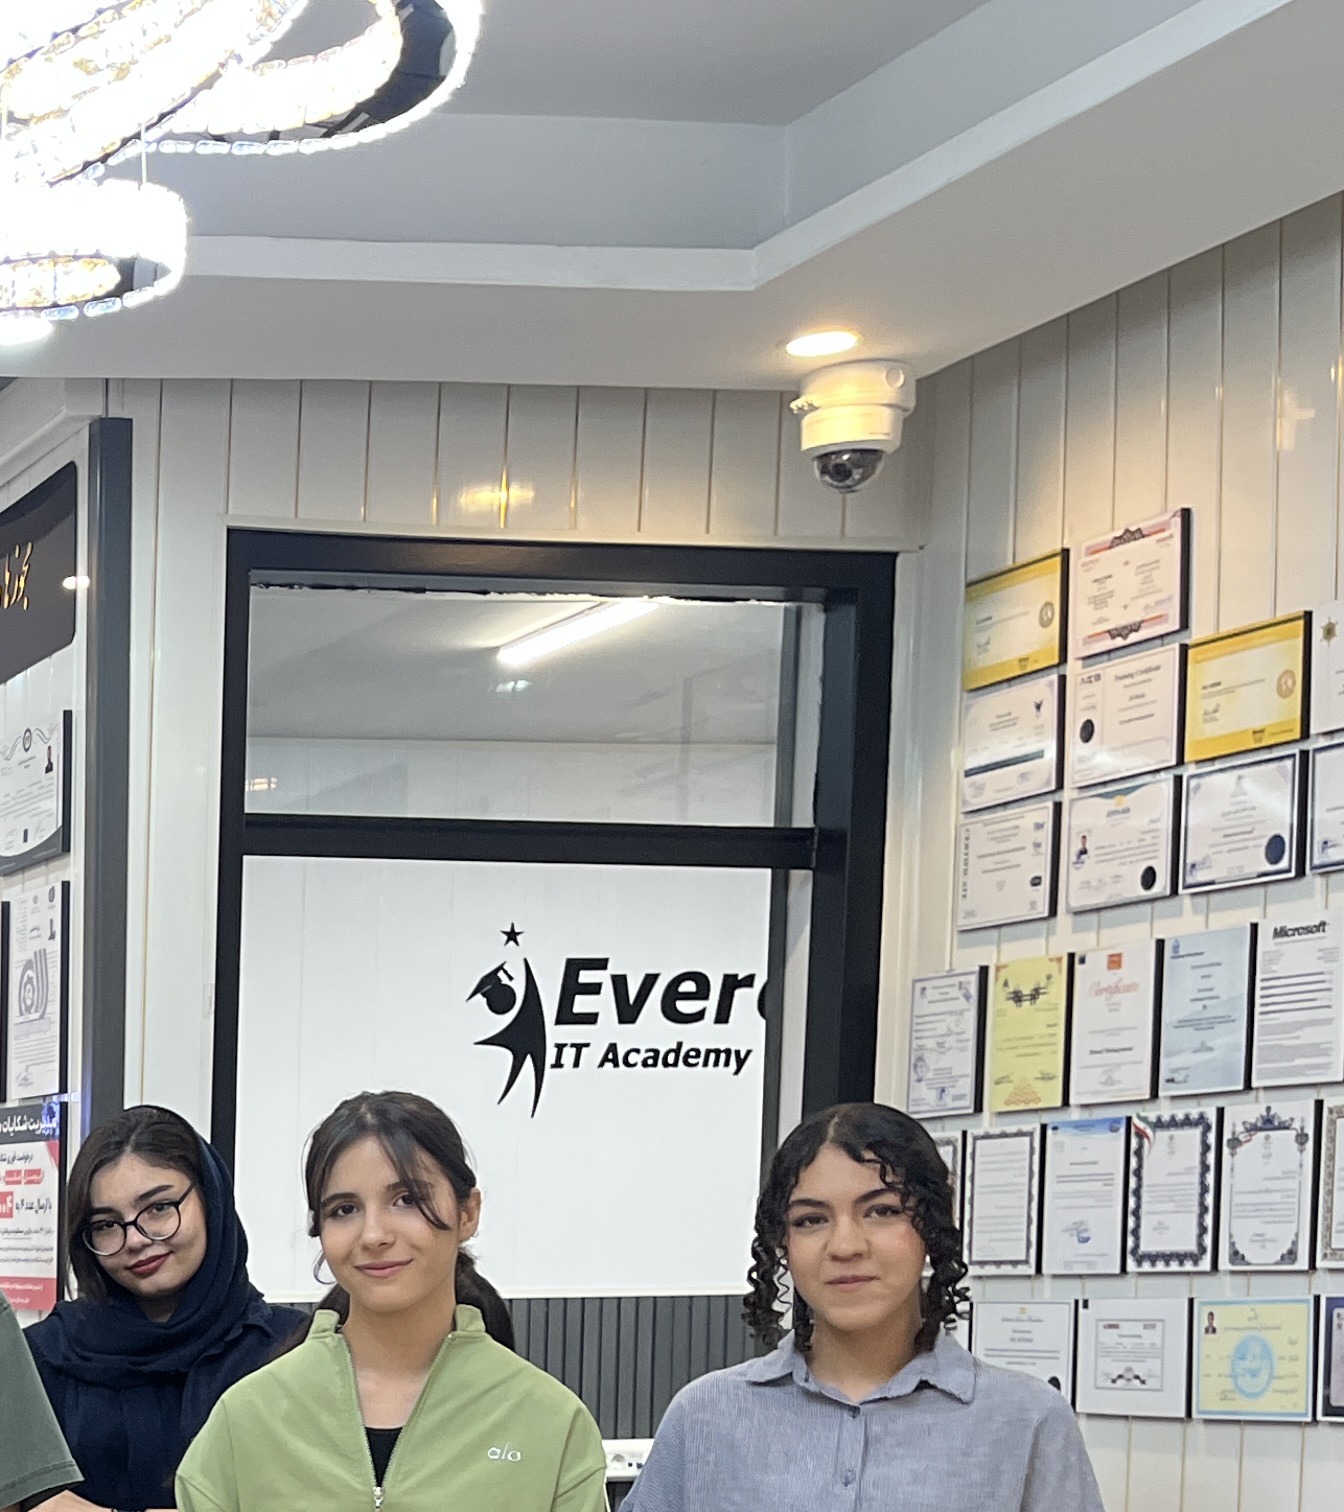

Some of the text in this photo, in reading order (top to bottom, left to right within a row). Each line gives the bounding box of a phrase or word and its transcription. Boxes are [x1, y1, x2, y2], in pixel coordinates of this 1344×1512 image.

[1272, 920, 1327, 939] Microsoft
[554, 957, 768, 1027] Ever
[550, 1041, 753, 1076] IT Academy
[2, 1115, 28, 1137] شکایات
[487, 1441, 522, 1462] alo
